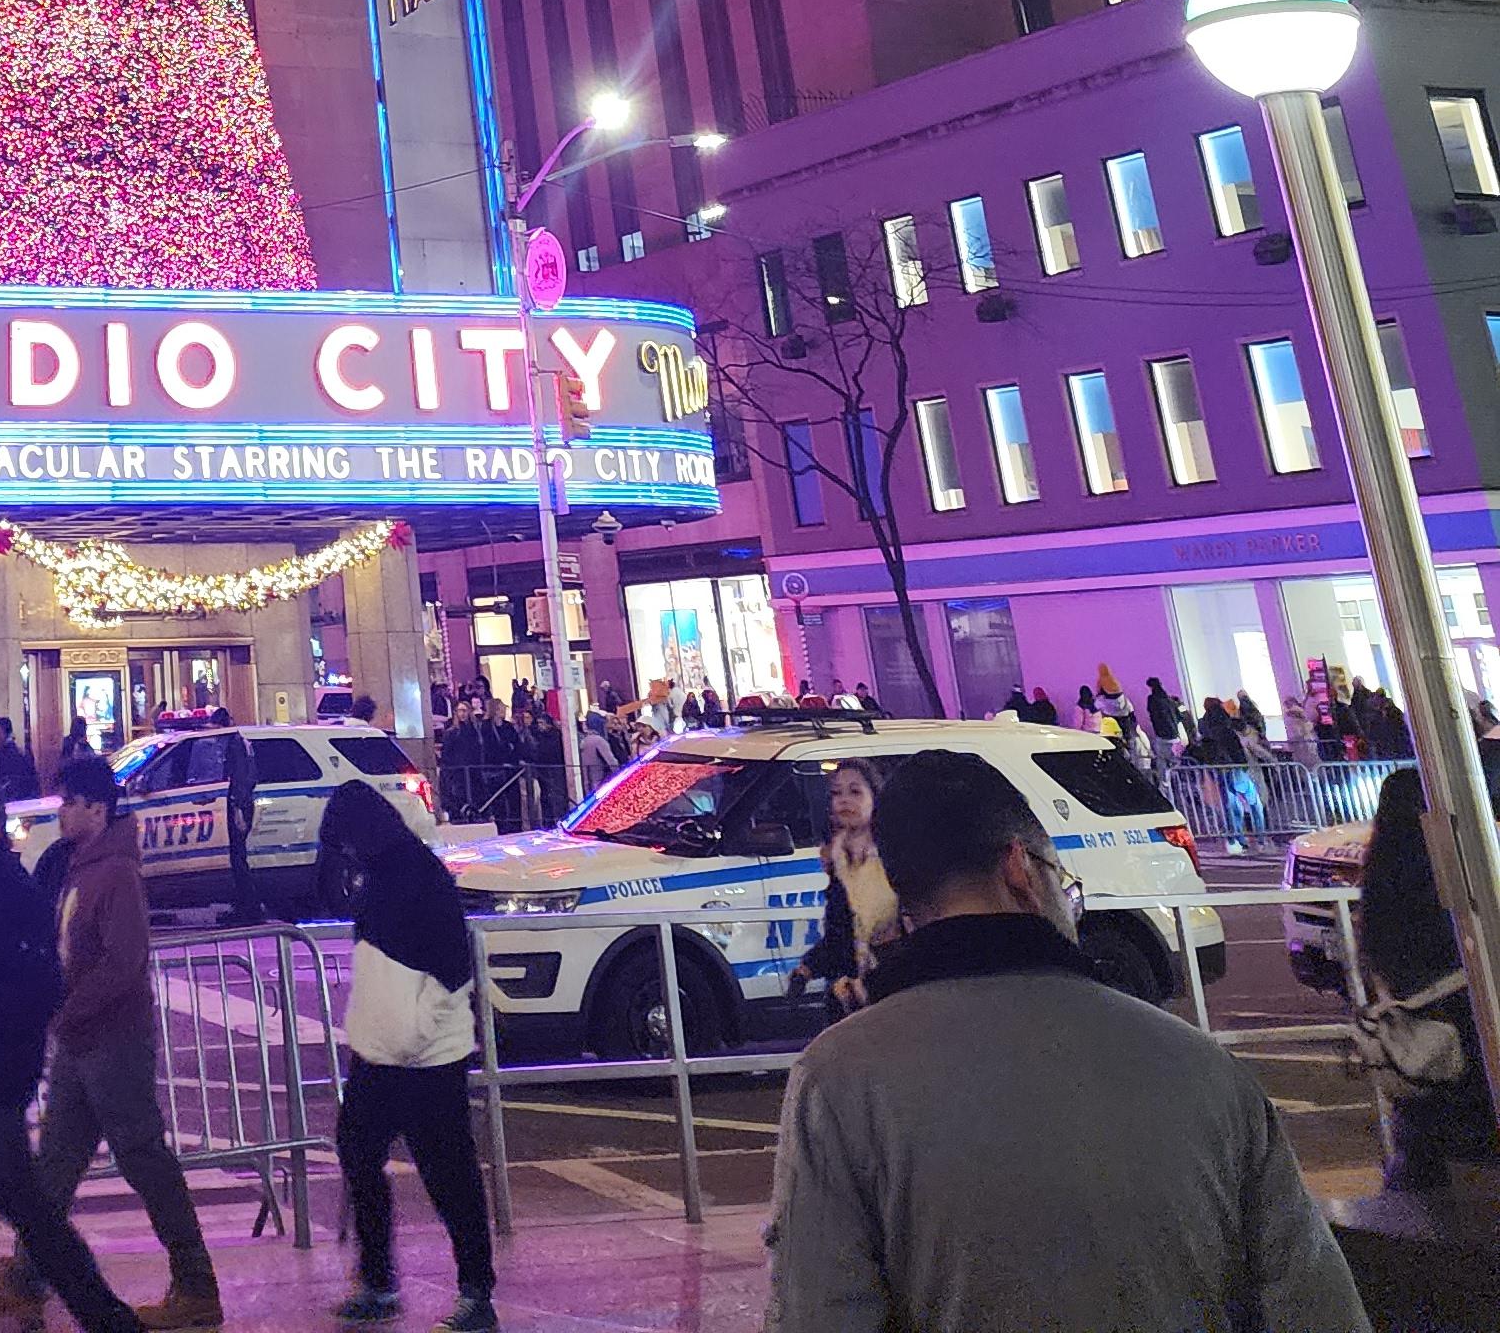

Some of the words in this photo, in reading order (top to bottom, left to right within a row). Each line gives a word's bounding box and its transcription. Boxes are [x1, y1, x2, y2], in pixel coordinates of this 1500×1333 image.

[316, 324, 618, 413] CITY
[173, 444, 351, 481] STARRING
[379, 446, 444, 481] THE
[467, 447, 574, 482] RADO
[594, 448, 661, 482] CITY
[1246, 533, 1322, 557] PARKER
[141, 809, 215, 851] NYPD
[606, 876, 663, 901] POLICE
